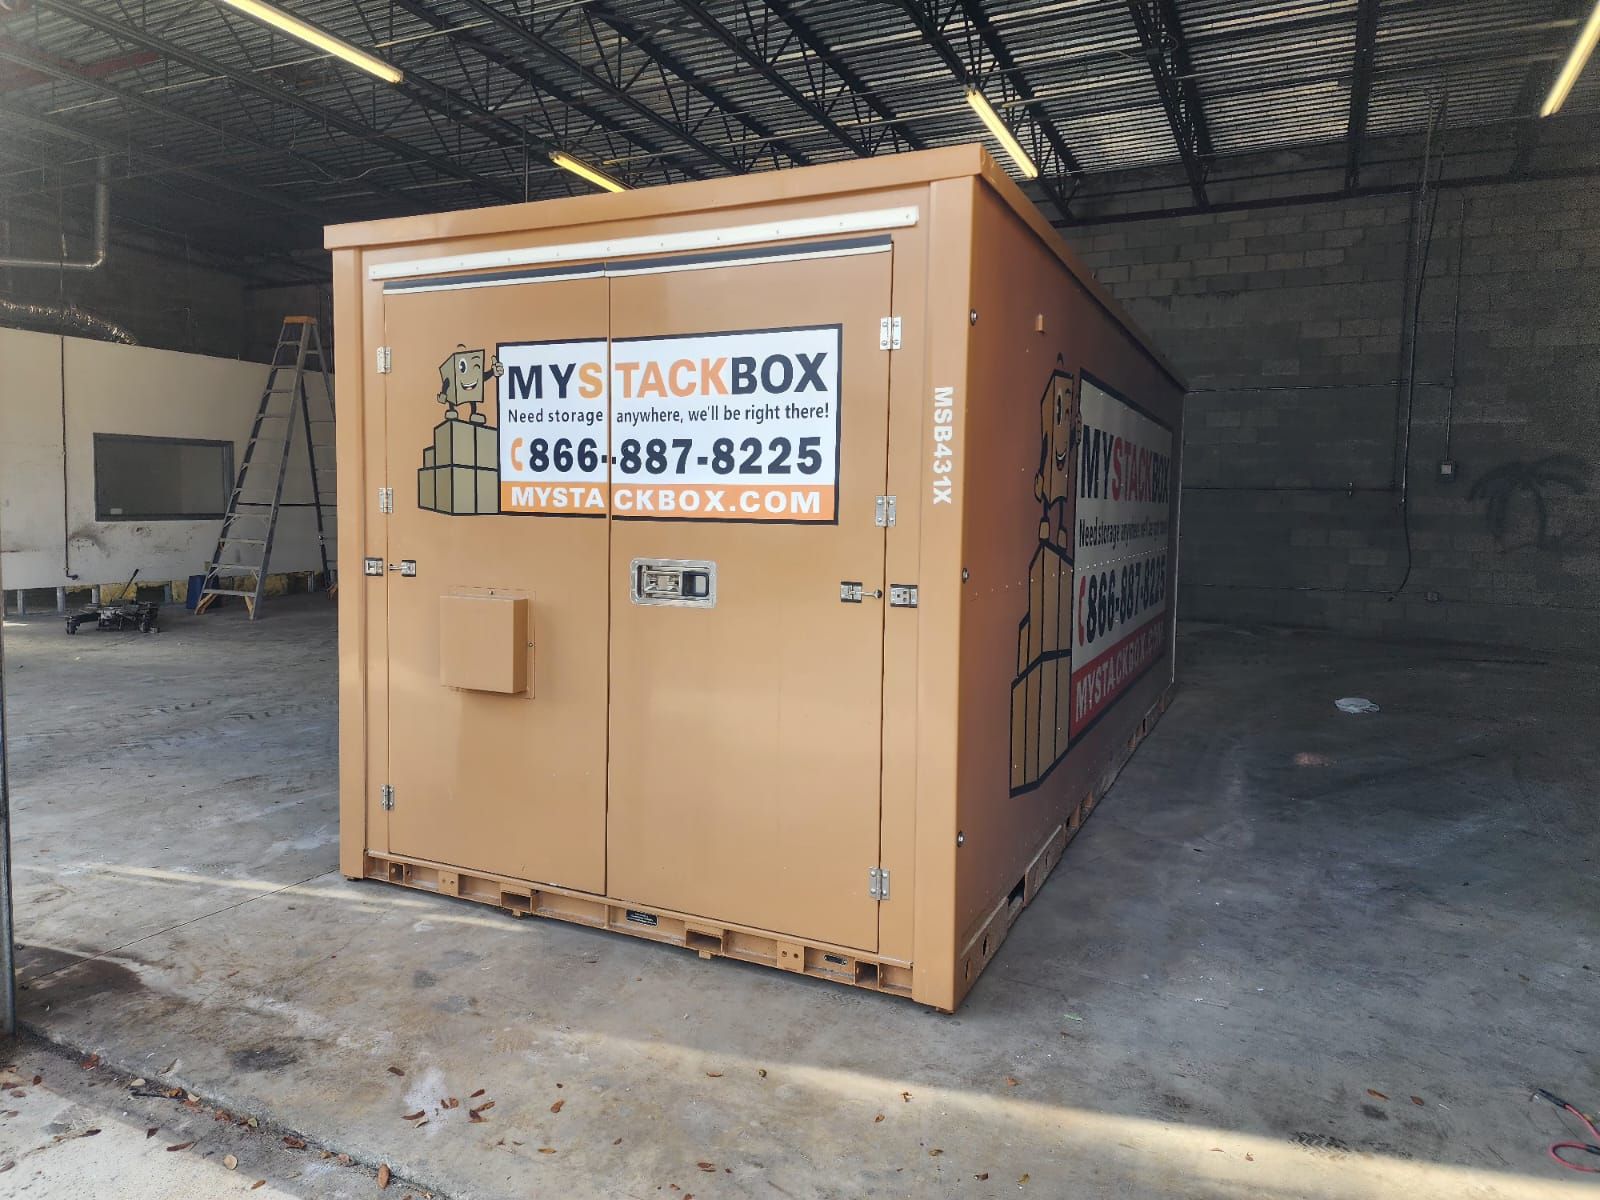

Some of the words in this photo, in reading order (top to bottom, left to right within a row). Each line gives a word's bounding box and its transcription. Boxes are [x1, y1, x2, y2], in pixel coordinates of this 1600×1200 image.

[507, 352, 829, 400] MYSTACKBOX
[508, 408, 543, 423] Need
[548, 409, 603, 426] storage
[616, 407, 683, 427] anywhere,
[688, 405, 719, 421] we'll
[723, 404, 741, 421] be
[745, 404, 780, 424] right
[785, 402, 829, 419] there!
[529, 436, 822, 475] 866-887-8225
[933, 386, 954, 505] MSB431X
[1080, 424, 1170, 504] MYSTACKBOX
[510, 486, 821, 514] MYSTACKBOX.COM
[1079, 516, 1098, 547] Need
